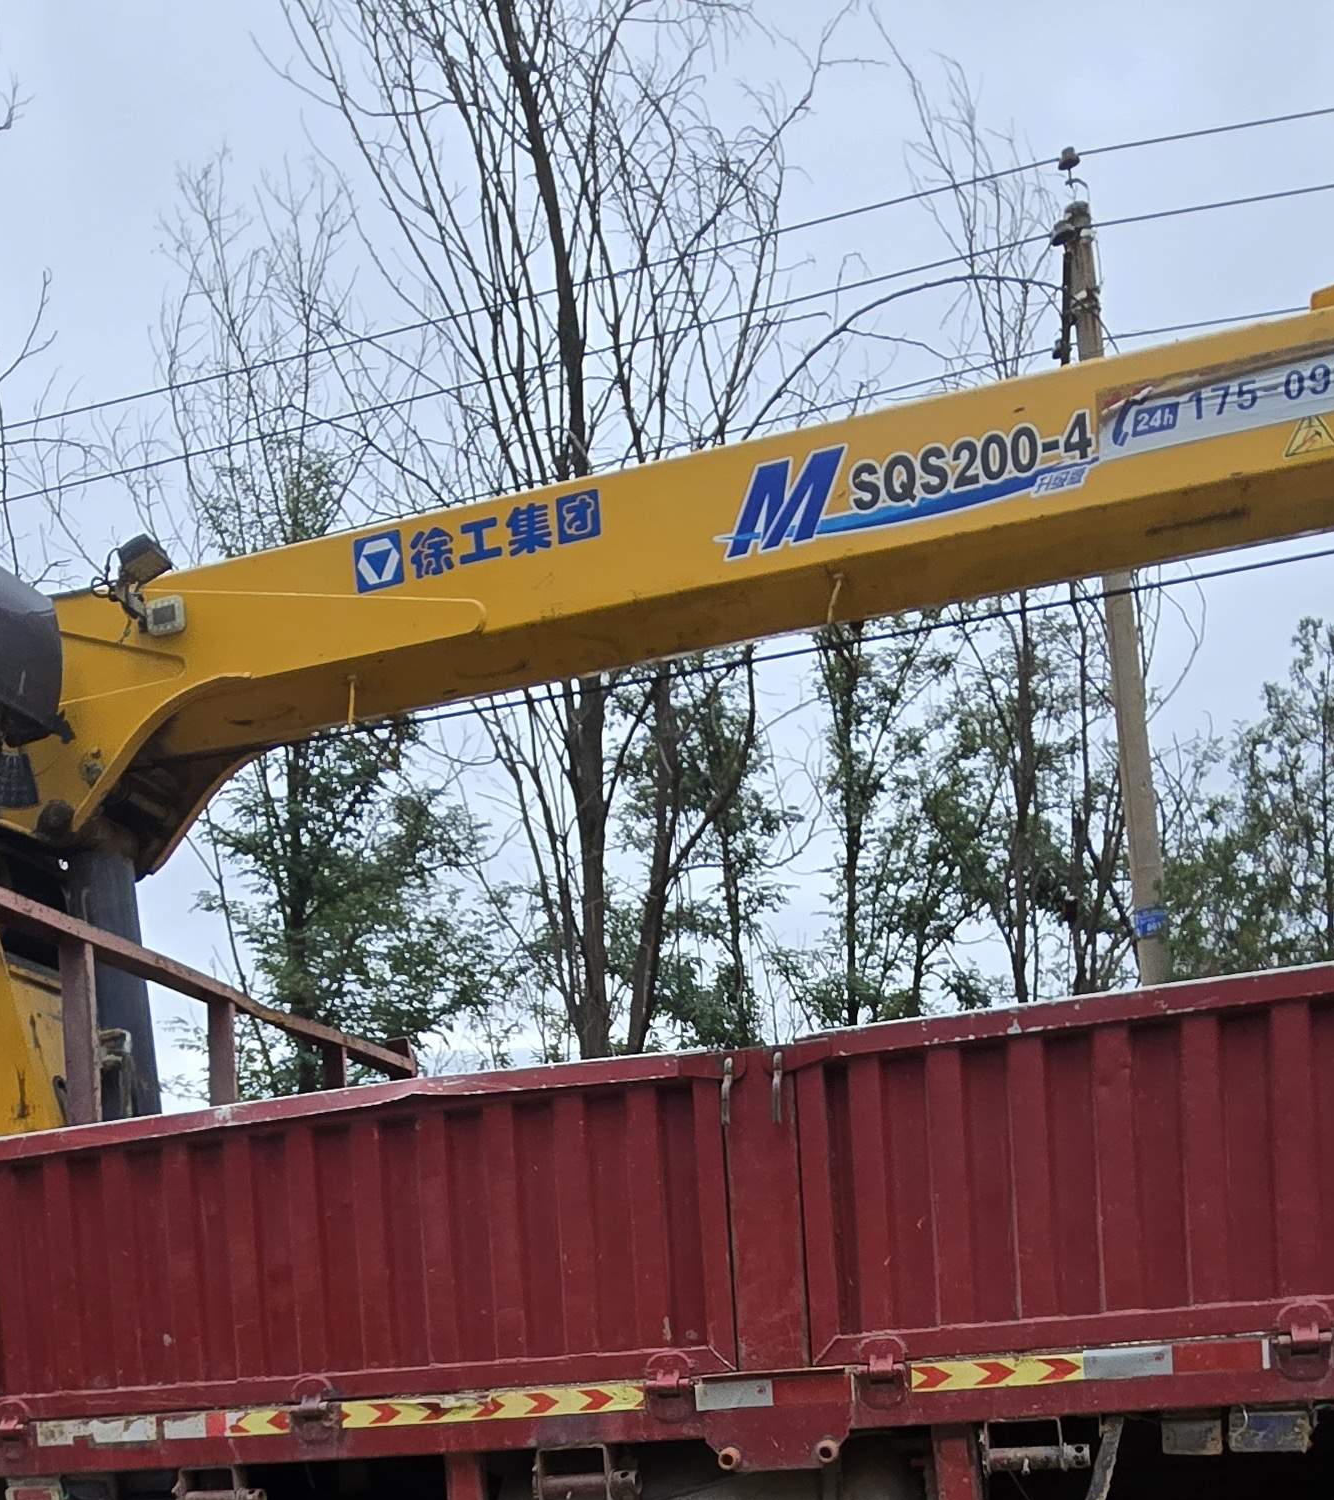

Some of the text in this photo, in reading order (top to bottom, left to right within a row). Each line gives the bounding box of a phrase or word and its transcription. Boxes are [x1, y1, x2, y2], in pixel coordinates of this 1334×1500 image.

[851, 411, 1093, 512] SQS200-4
[1134, 407, 1175, 432] 24h
[410, 489, 602, 580] 徐工集团
